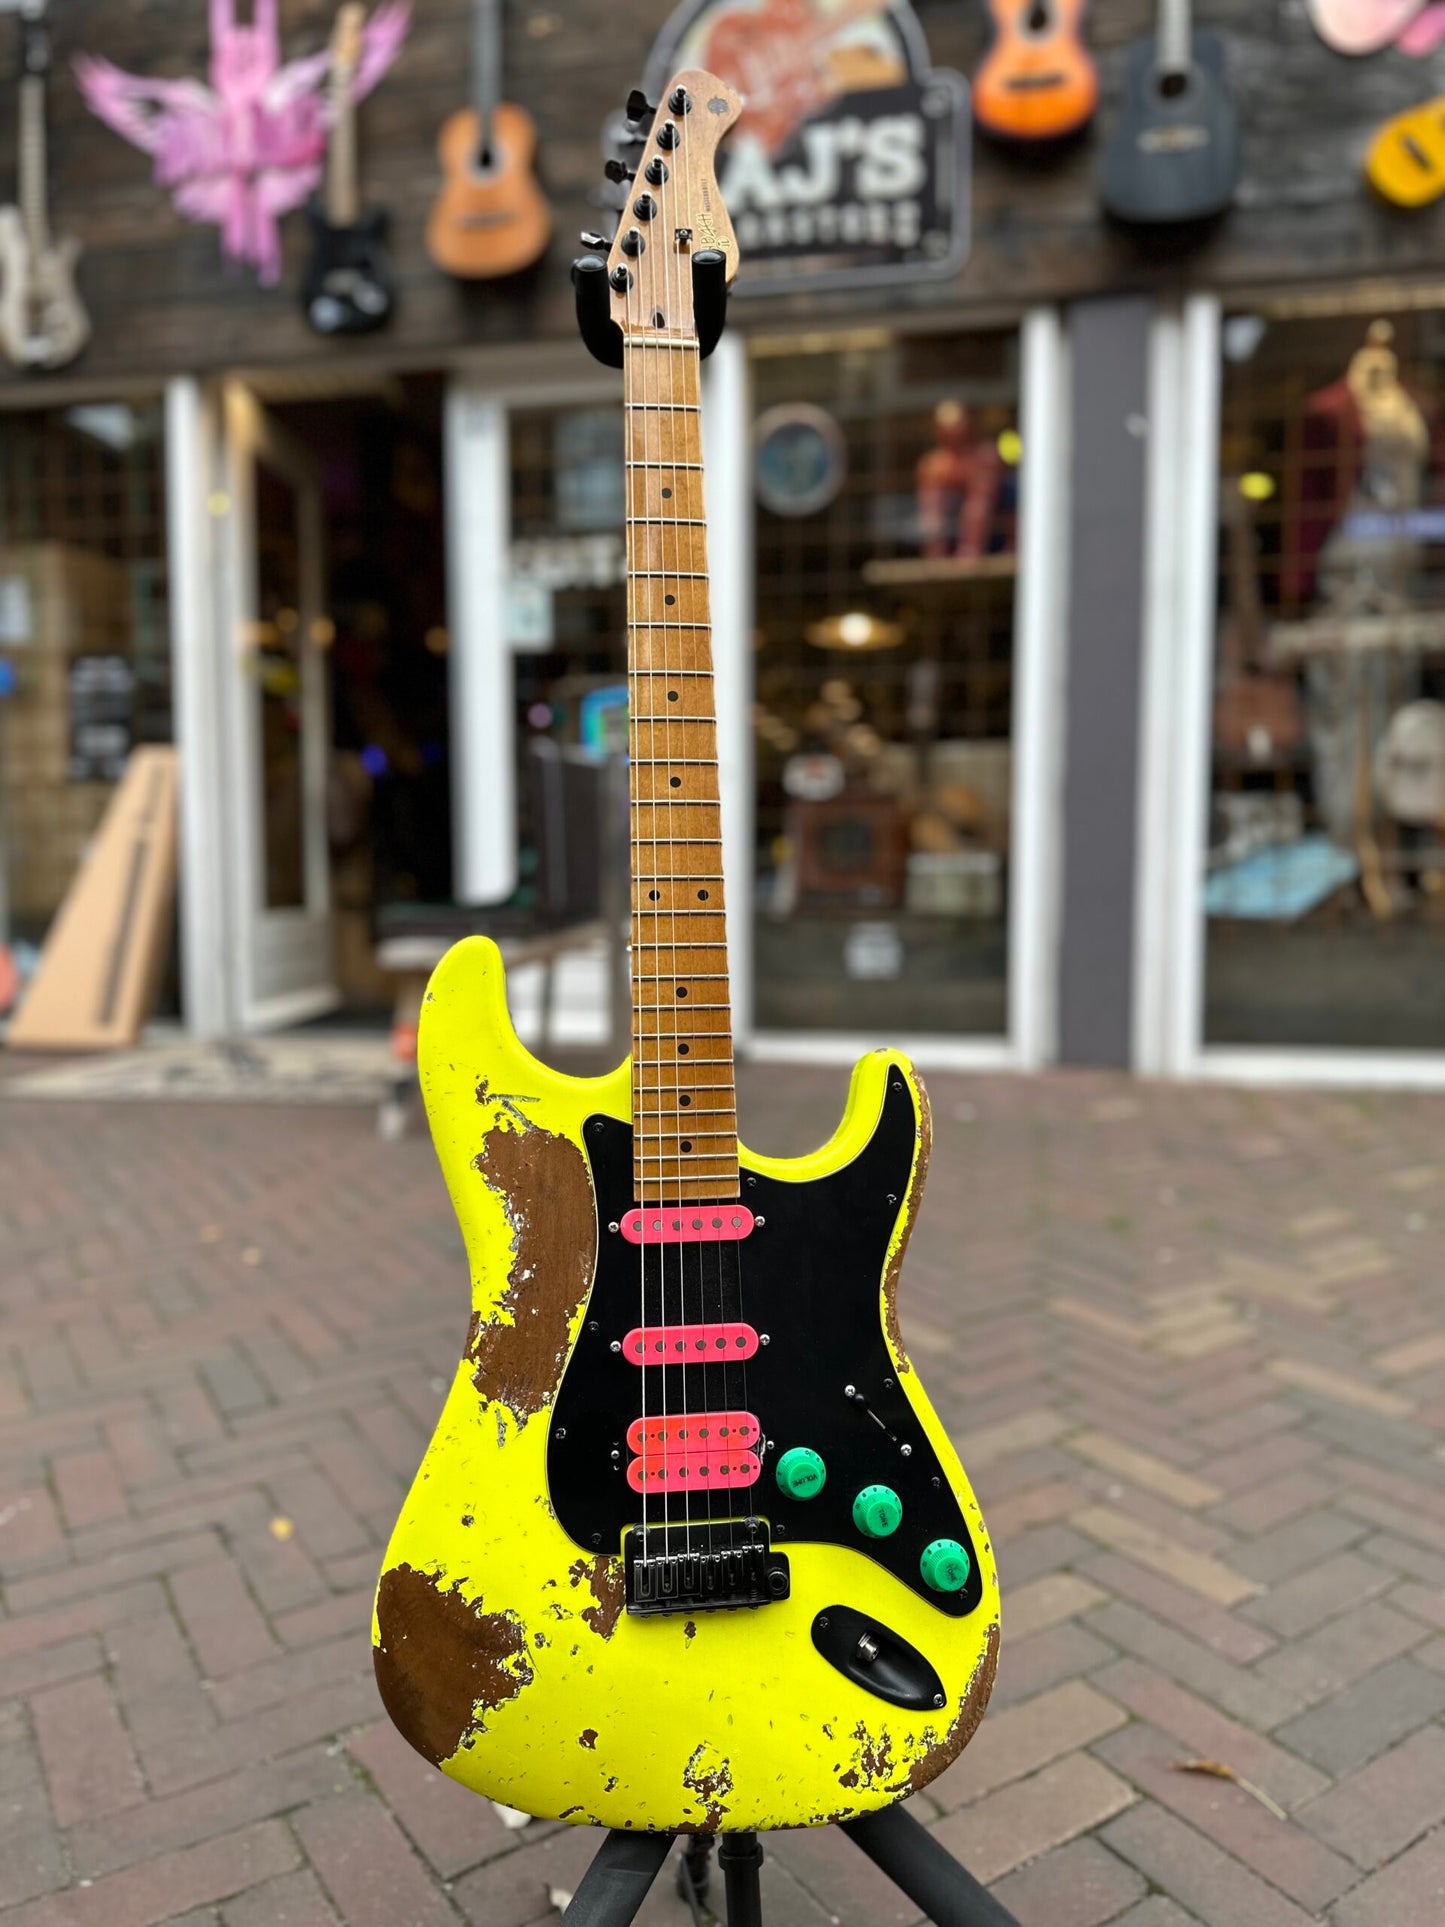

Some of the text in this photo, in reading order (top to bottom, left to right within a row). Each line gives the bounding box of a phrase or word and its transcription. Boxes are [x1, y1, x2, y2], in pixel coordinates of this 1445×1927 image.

[719, 116, 925, 210] AJ'S
[792, 1473, 818, 1488] VOLUME
[879, 1508, 889, 1528] TONE
